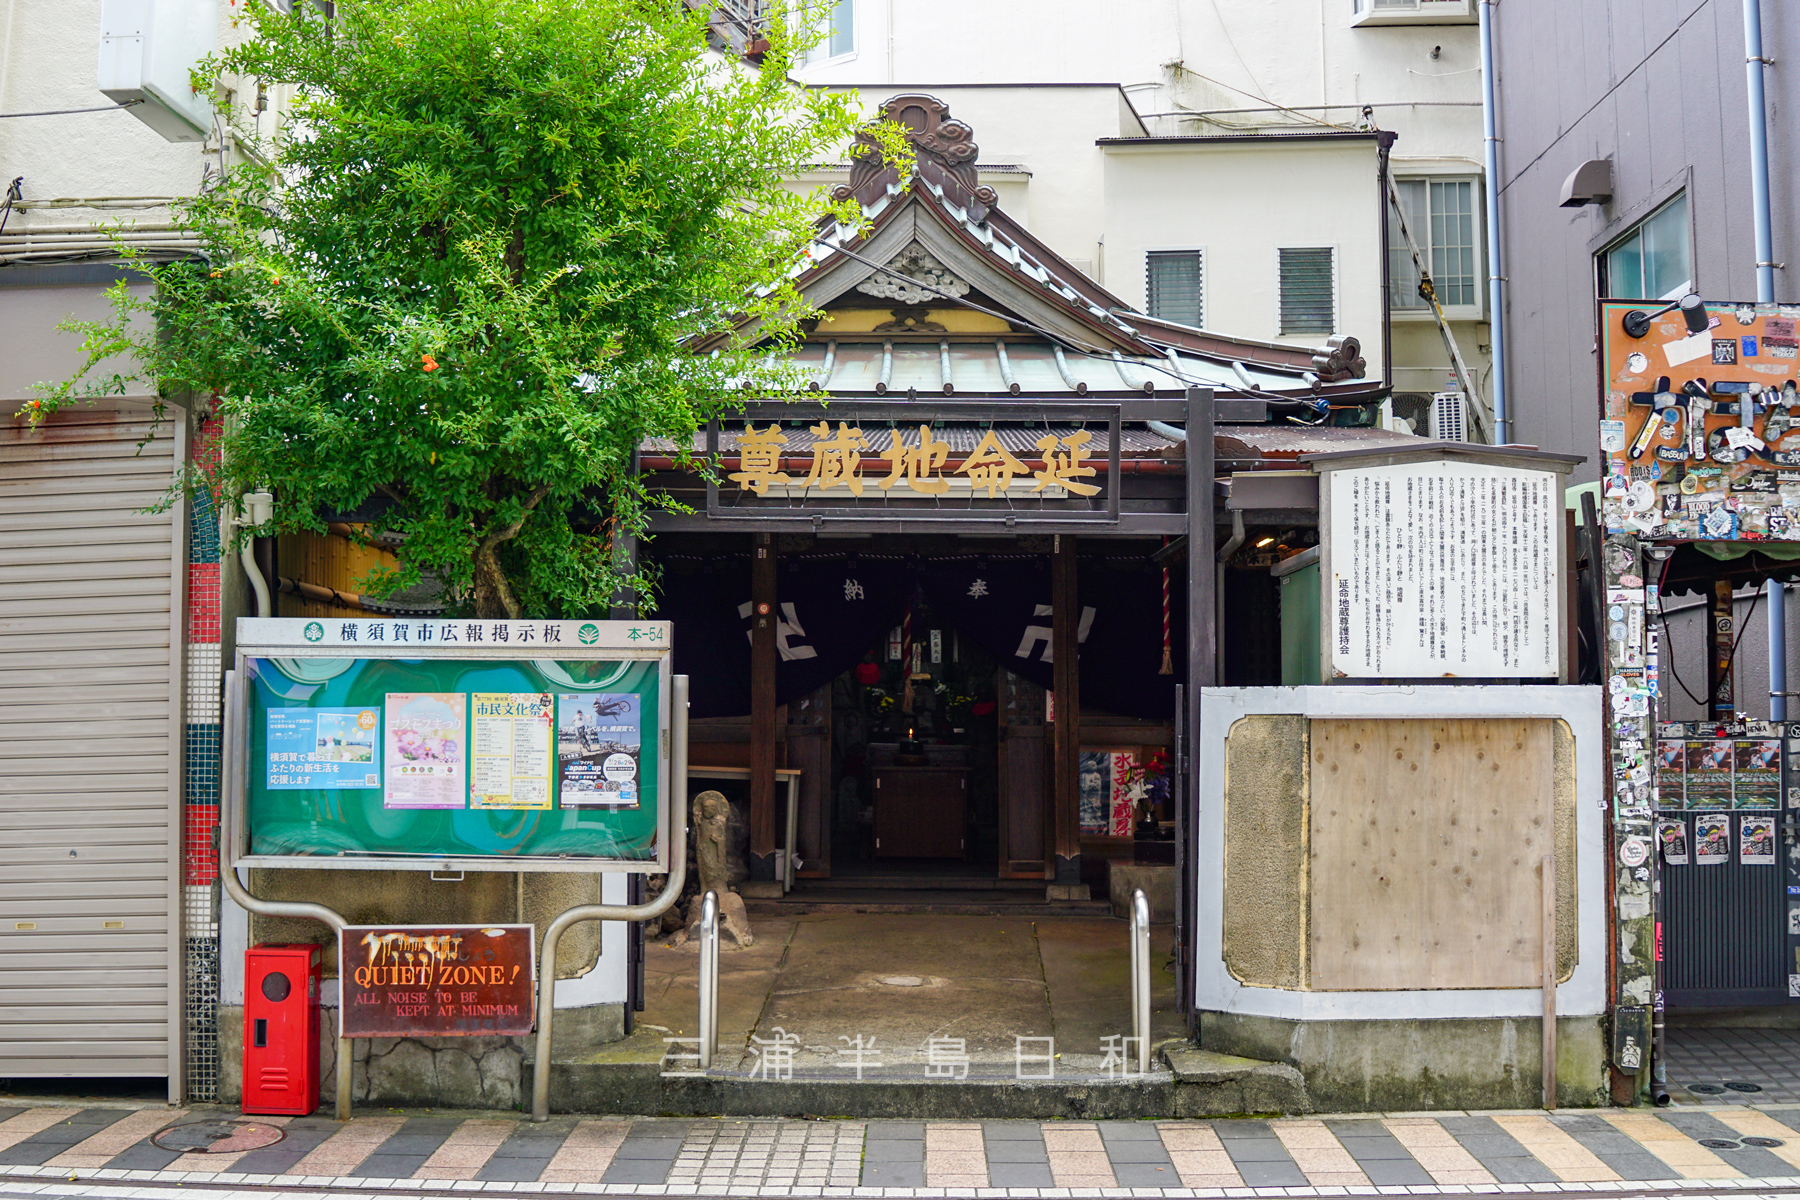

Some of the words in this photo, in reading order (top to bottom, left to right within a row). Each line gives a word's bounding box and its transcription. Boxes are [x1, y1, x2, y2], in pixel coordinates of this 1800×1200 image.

[1338, 578, 1350, 655] 延命地蔵尊護持会
[339, 623, 563, 644] 横須賀市広報掲示板
[627, 627, 664, 643] 本-54
[476, 702, 542, 716] 市民文化祭
[361, 715, 373, 725] 60
[389, 718, 462, 731] コスモスまつり
[270, 752, 334, 762] 横須賀で暮らす
[270, 763, 340, 773] ふたりの新生活を
[270, 774, 311, 785] 応援します
[354, 965, 431, 988] QUIET
[354, 992, 381, 1005] ALL
[387, 992, 428, 1003] NOISE
[435, 992, 453, 1003] TO
[460, 992, 478, 1003] BE
[396, 1005, 430, 1016] KEPT
[437, 1005, 455, 1016] AT
[462, 1004, 519, 1016] MINIMUM
